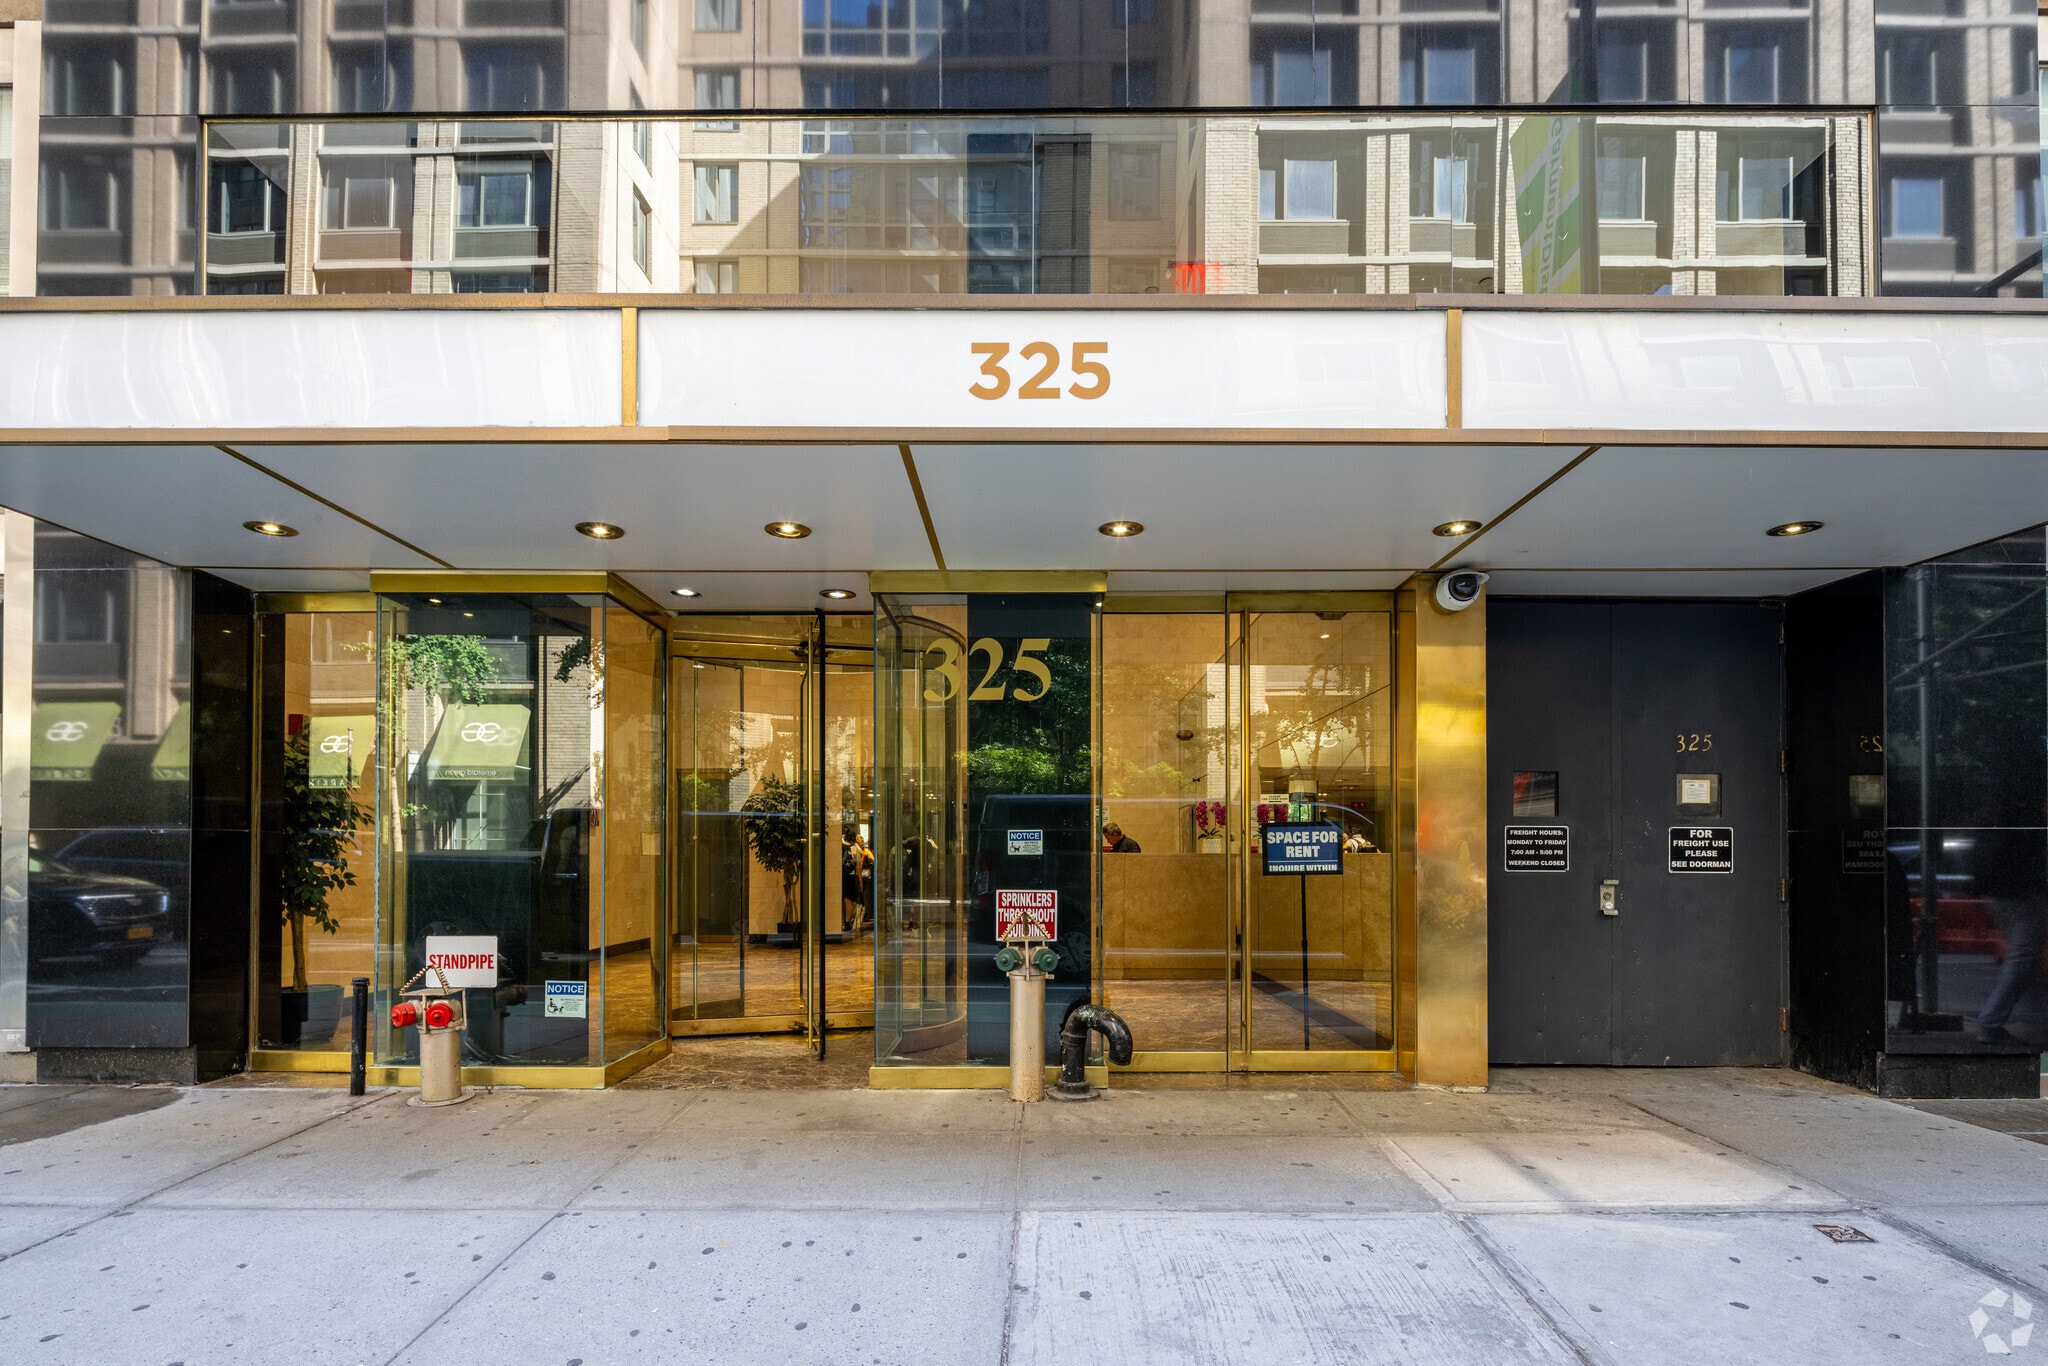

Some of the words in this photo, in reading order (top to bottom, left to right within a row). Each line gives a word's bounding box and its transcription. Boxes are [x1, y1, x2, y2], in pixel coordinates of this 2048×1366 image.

[968, 341, 1111, 400] 325
[923, 637, 1051, 702] 325
[1676, 734, 1712, 753] 325
[1010, 832, 1040, 840] NOTICE
[1267, 831, 1309, 844] SPACE
[1312, 831, 1338, 844] FOR
[1690, 830, 1712, 838] FOR
[1286, 845, 1320, 858] RENT
[1306, 864, 1337, 872] WITHIN
[1002, 892, 1052, 907] SPRINKLERS
[429, 954, 495, 970] STANDPIPE
[547, 985, 584, 993] NOTICE
